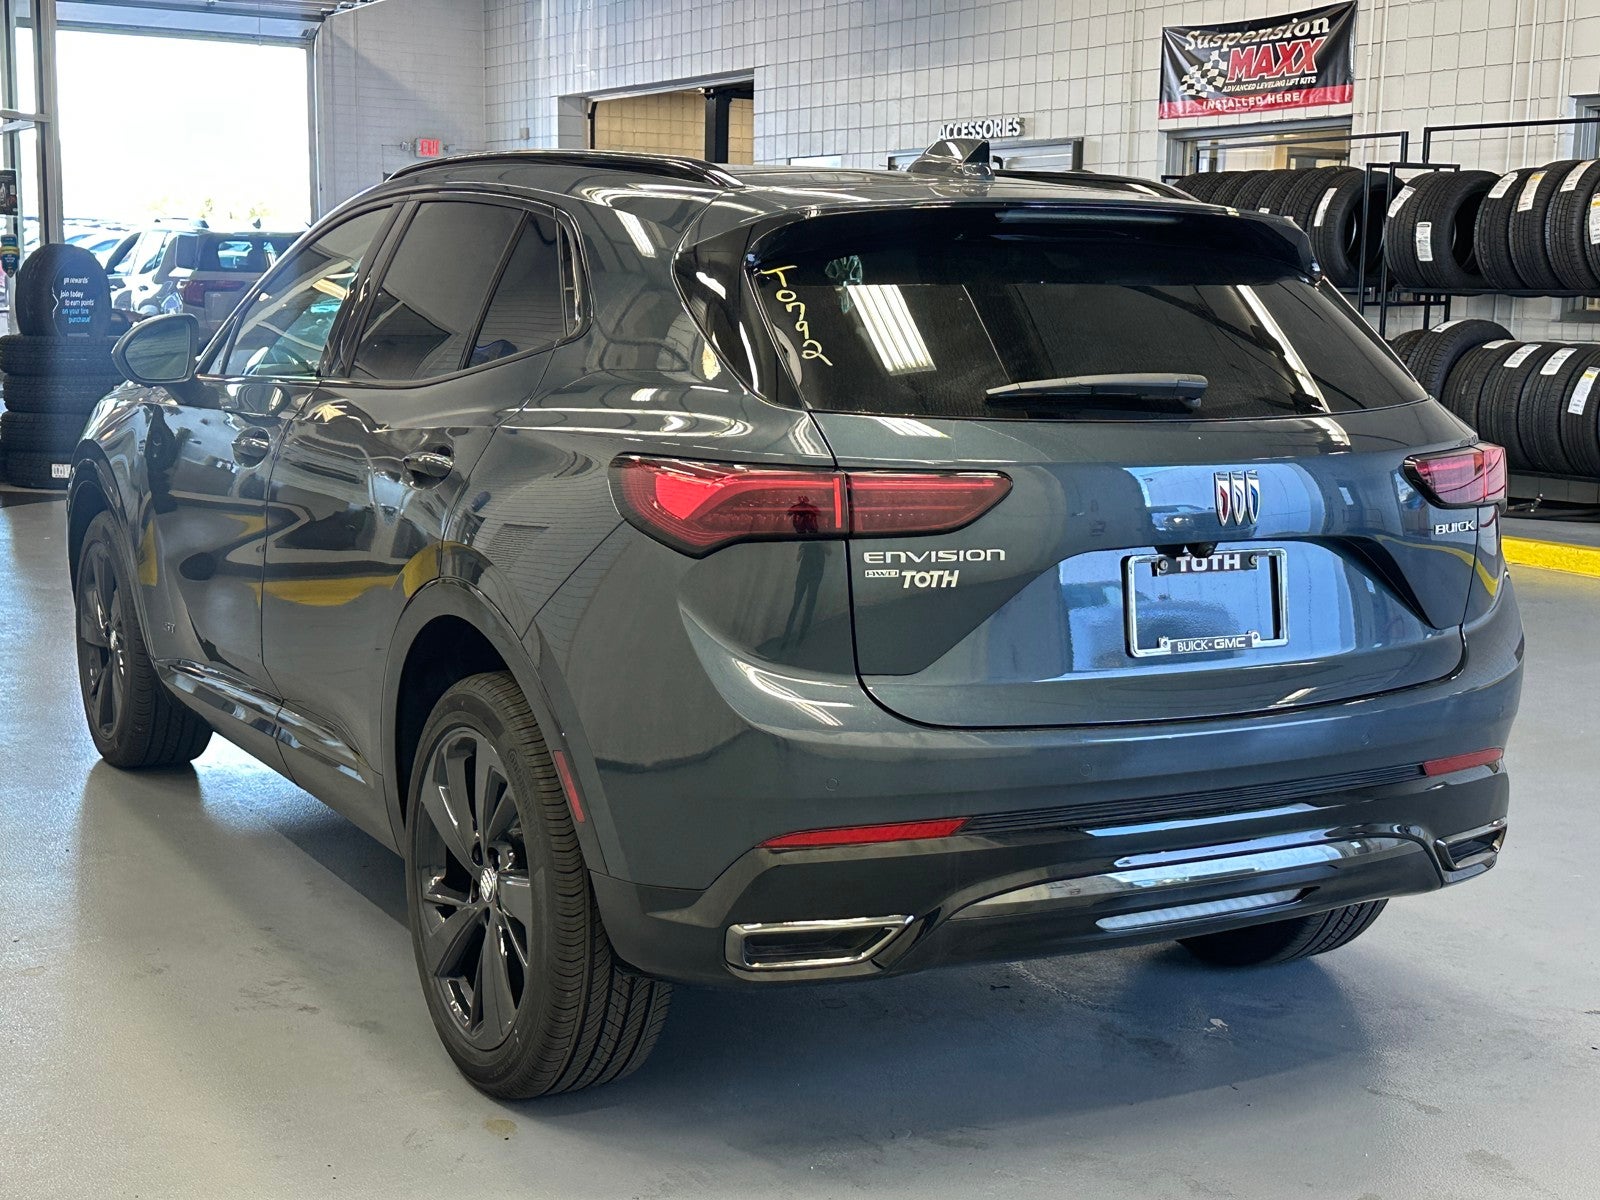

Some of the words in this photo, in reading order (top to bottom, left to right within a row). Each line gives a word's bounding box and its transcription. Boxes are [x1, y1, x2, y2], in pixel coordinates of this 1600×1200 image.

[1184, 17, 1330, 51] Suspension
[1225, 36, 1329, 83] MAXX
[1220, 83, 1256, 93] ADVANCED
[1256, 79, 1286, 90] LEVELING
[1285, 78, 1300, 87] LIFT
[1300, 75, 1317, 85] KITS
[1202, 96, 1264, 111] INSTALLED
[1266, 92, 1300, 104] HERE
[938, 117, 1022, 139] ACCESSORIES
[1436, 520, 1475, 535] BUICK
[863, 549, 1006, 564] ENVISION
[1175, 553, 1241, 572] TOTH
[866, 570, 898, 578] AWD
[901, 569, 960, 589] TOTH
